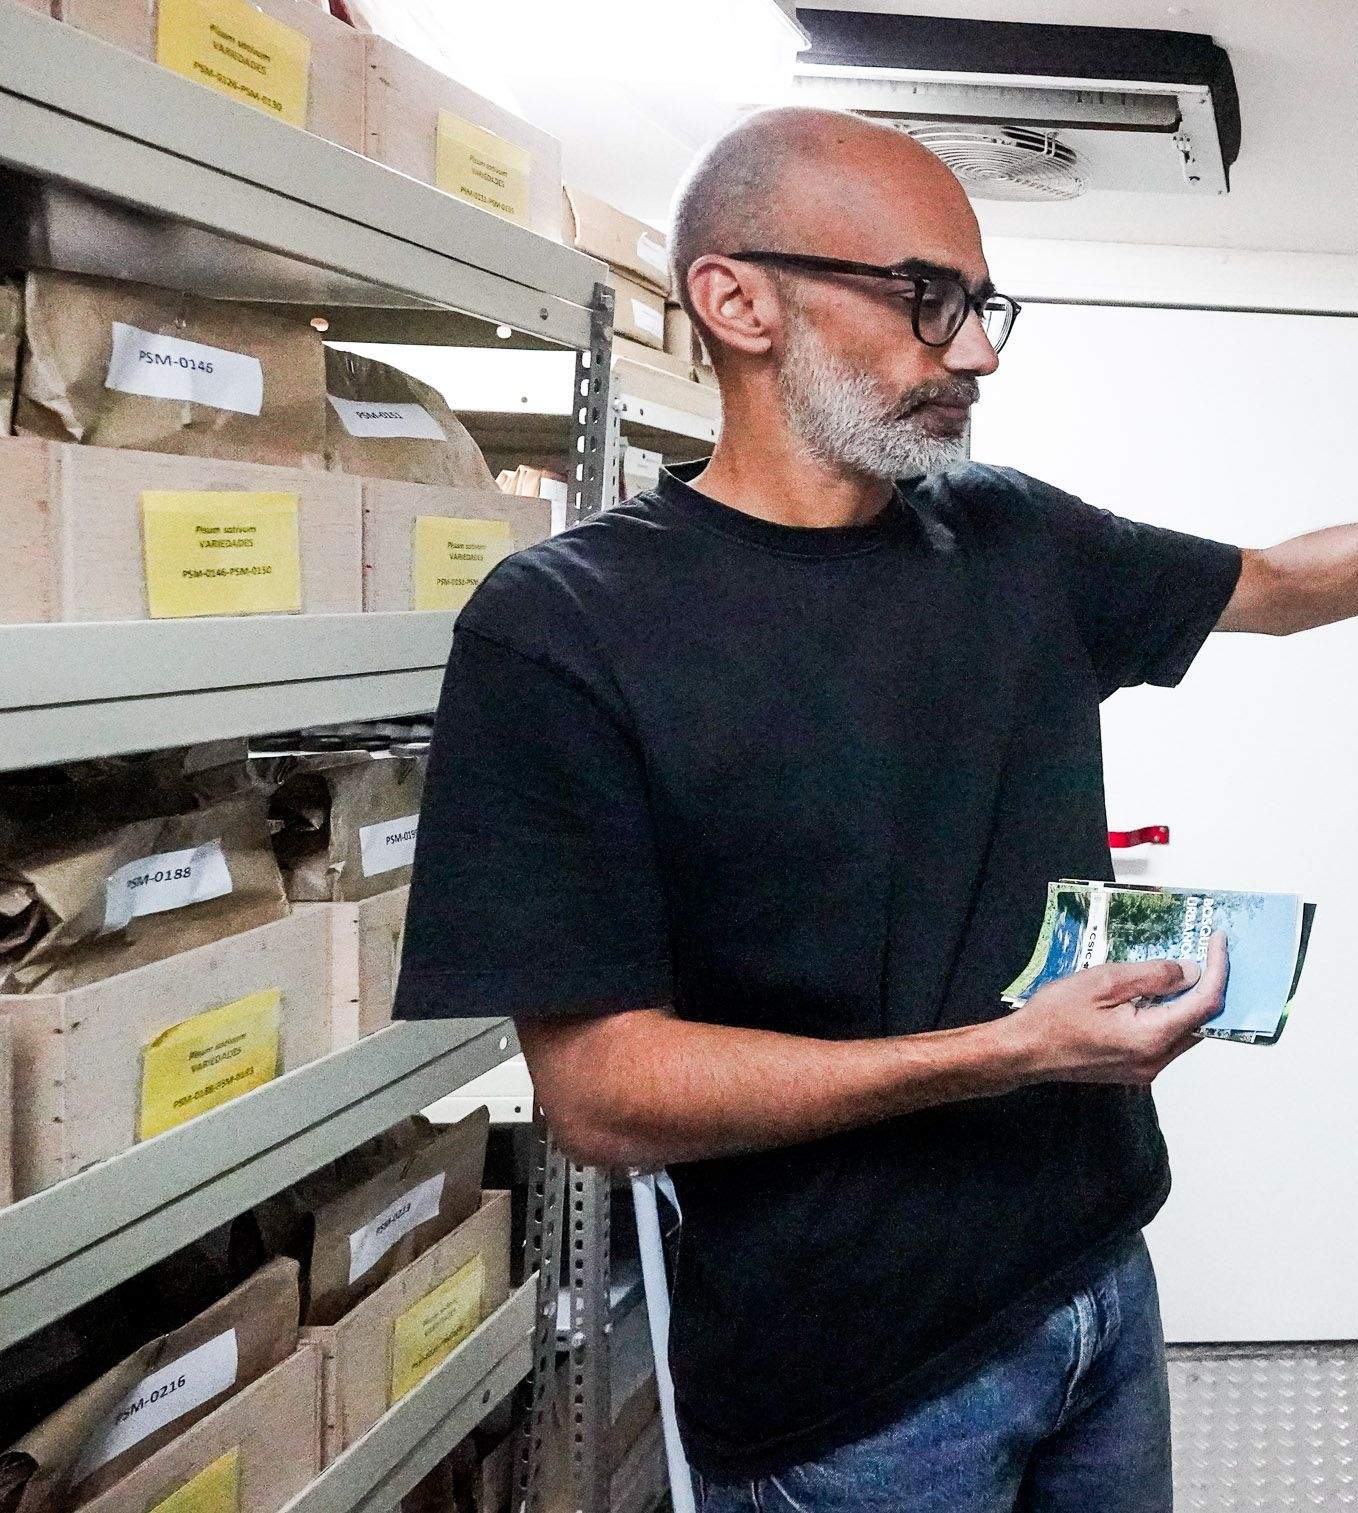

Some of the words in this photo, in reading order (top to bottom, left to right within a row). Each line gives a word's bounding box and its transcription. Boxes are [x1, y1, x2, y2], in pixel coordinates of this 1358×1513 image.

[139, 350, 214, 374] PSM-0146
[199, 538, 254, 549] VARIEDADES
[1085, 932, 1097, 960] CSIC
